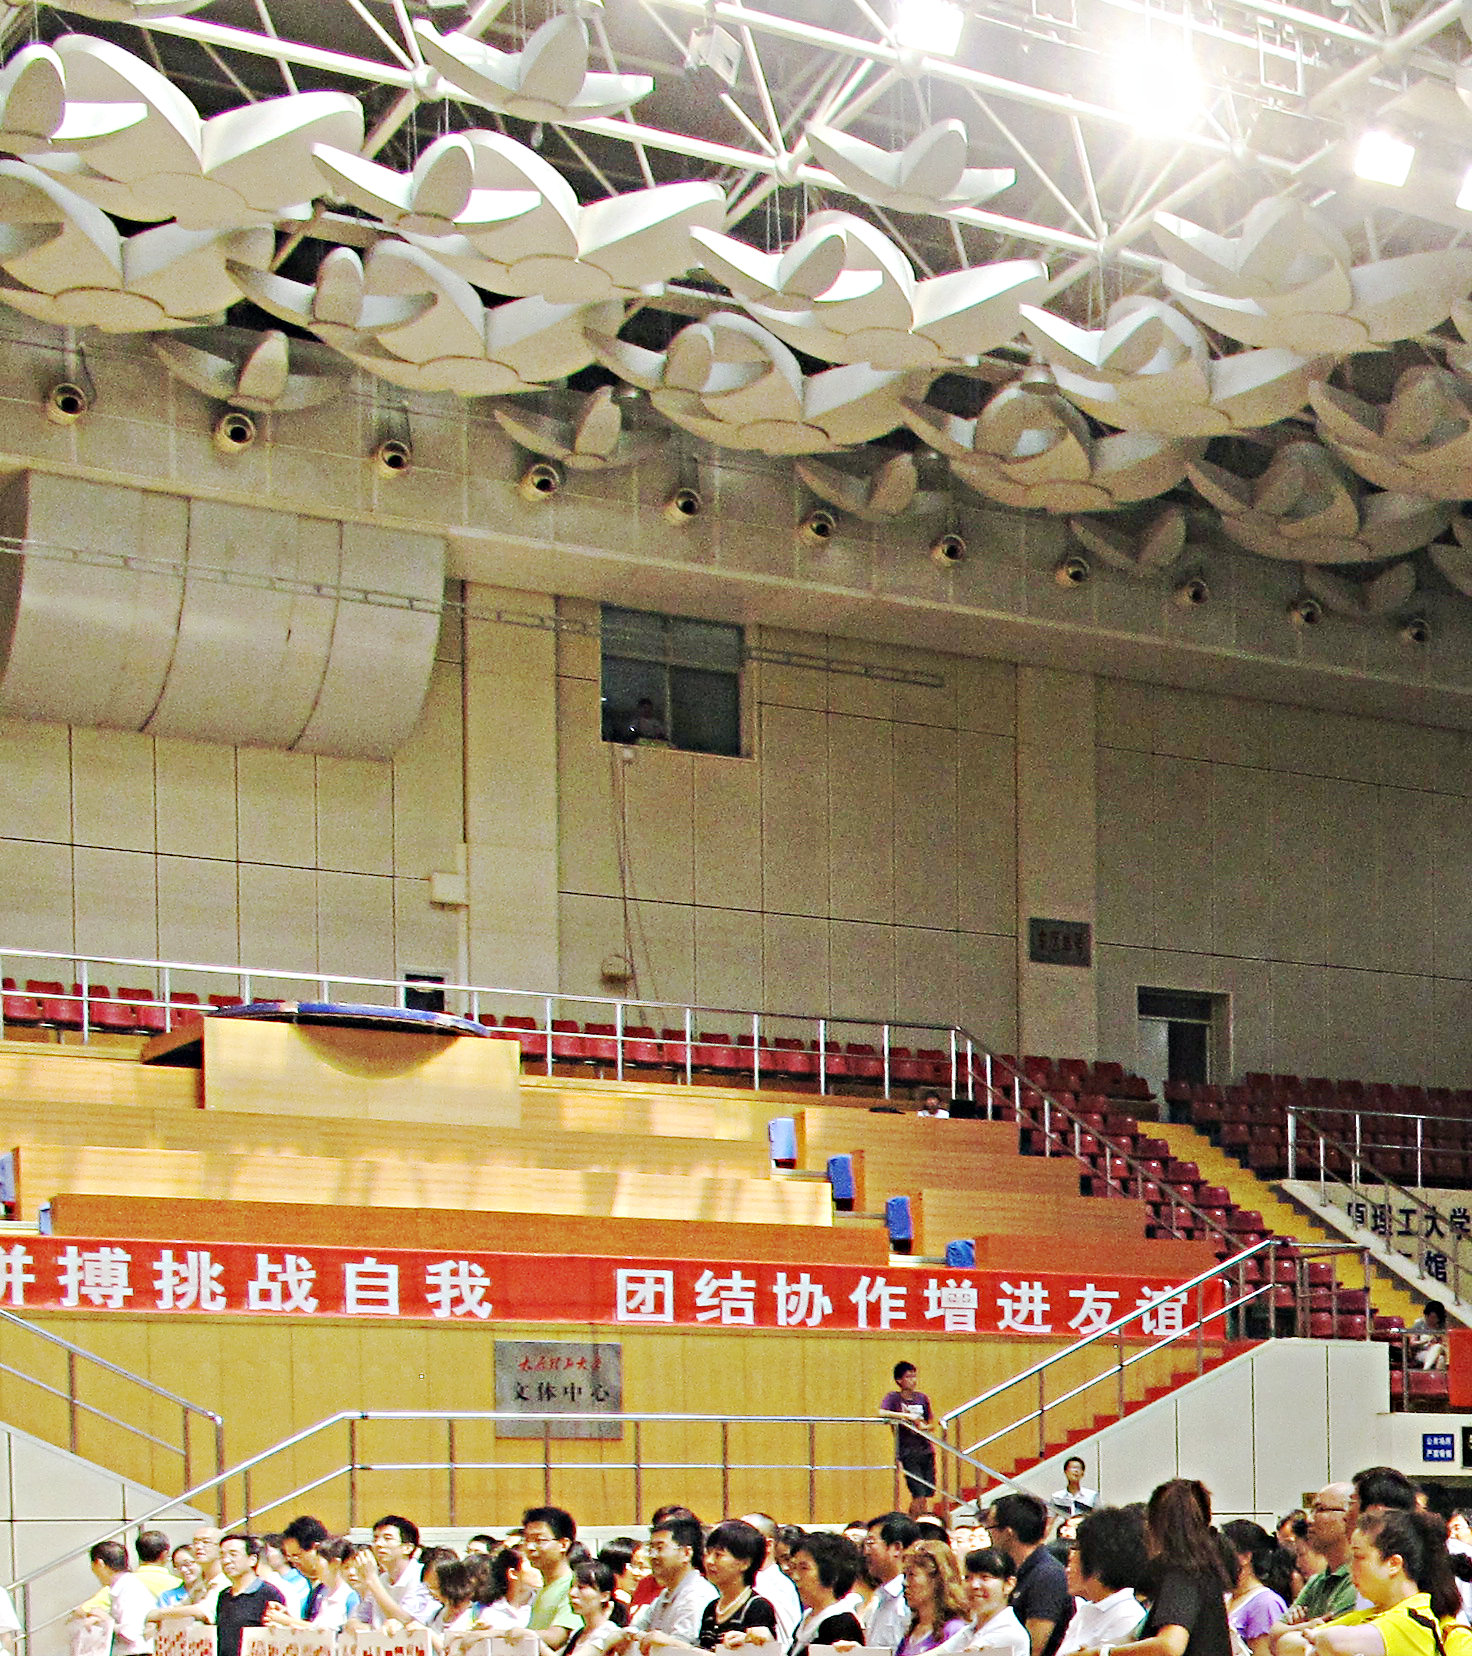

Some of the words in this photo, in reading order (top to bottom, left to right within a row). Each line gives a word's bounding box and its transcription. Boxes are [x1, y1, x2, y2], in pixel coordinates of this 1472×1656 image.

[1347, 1202, 1471, 1241] 原理工大学
[616, 1267, 1190, 1336] 团结协作增进友谊
